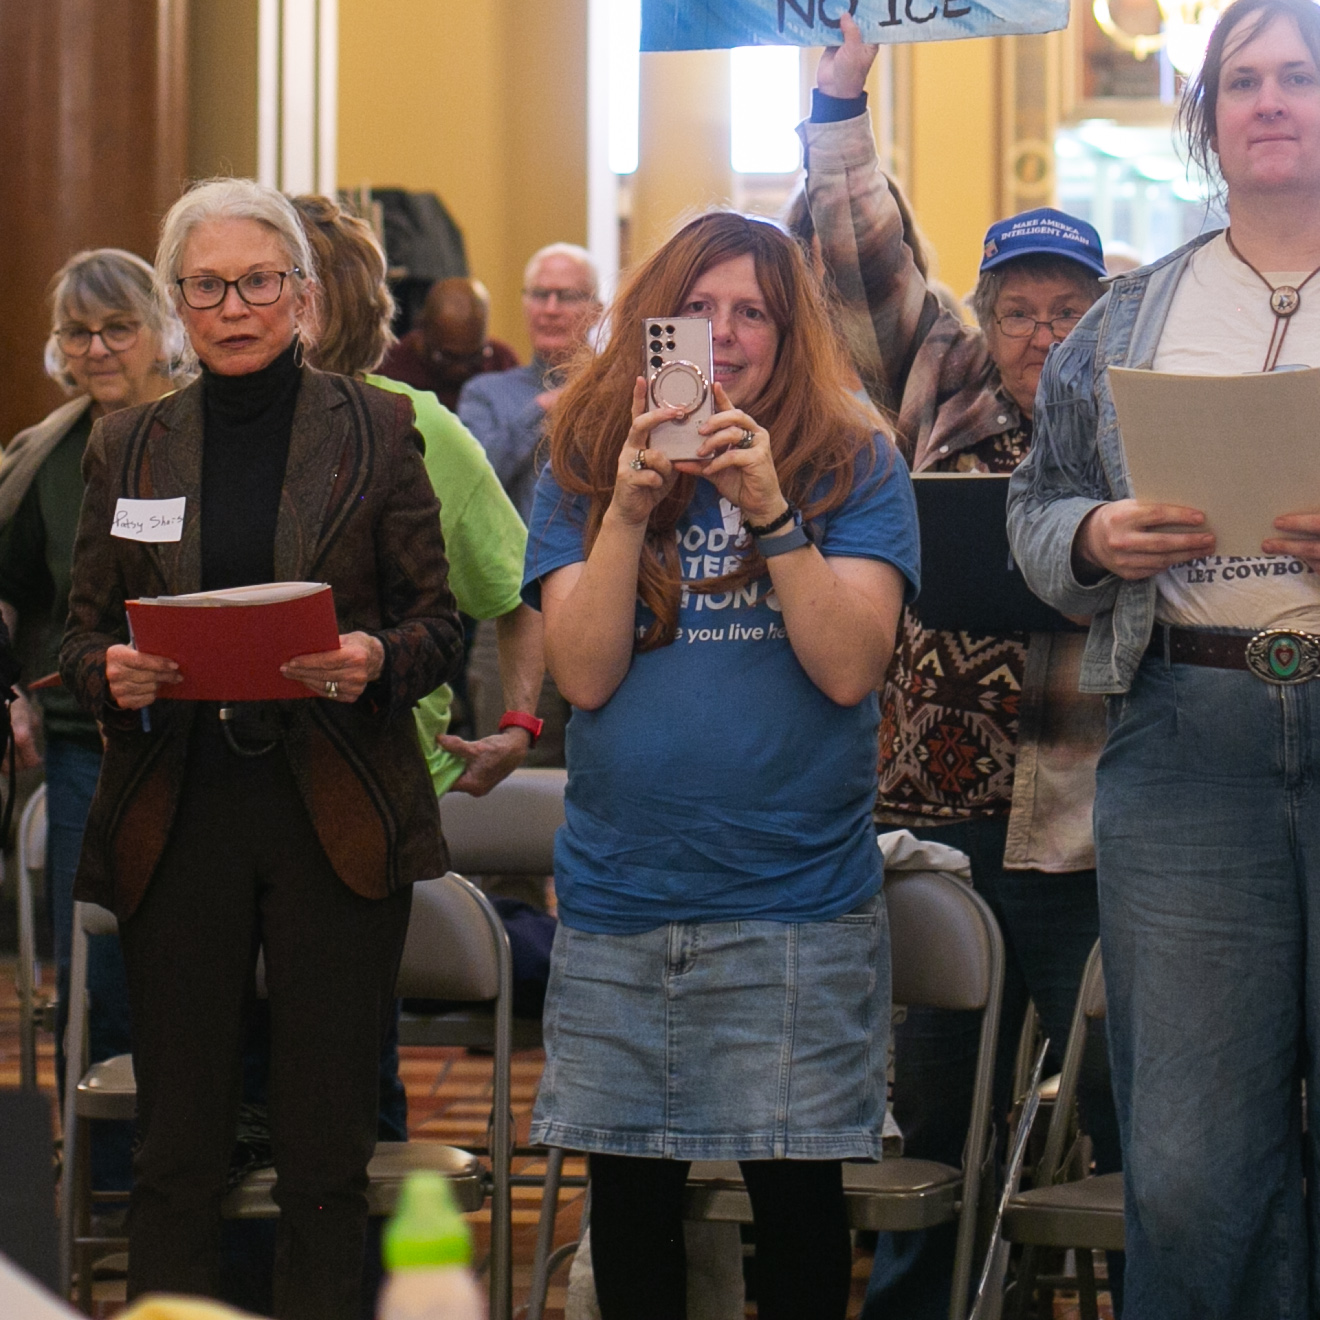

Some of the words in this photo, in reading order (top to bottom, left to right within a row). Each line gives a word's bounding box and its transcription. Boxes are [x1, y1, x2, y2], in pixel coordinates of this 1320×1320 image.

[1012, 219, 1039, 230] MAKE
[1040, 218, 1079, 235] AMERICA
[1187, 568, 1217, 584] LET
[688, 628, 724, 644] you
[728, 623, 764, 641] live
